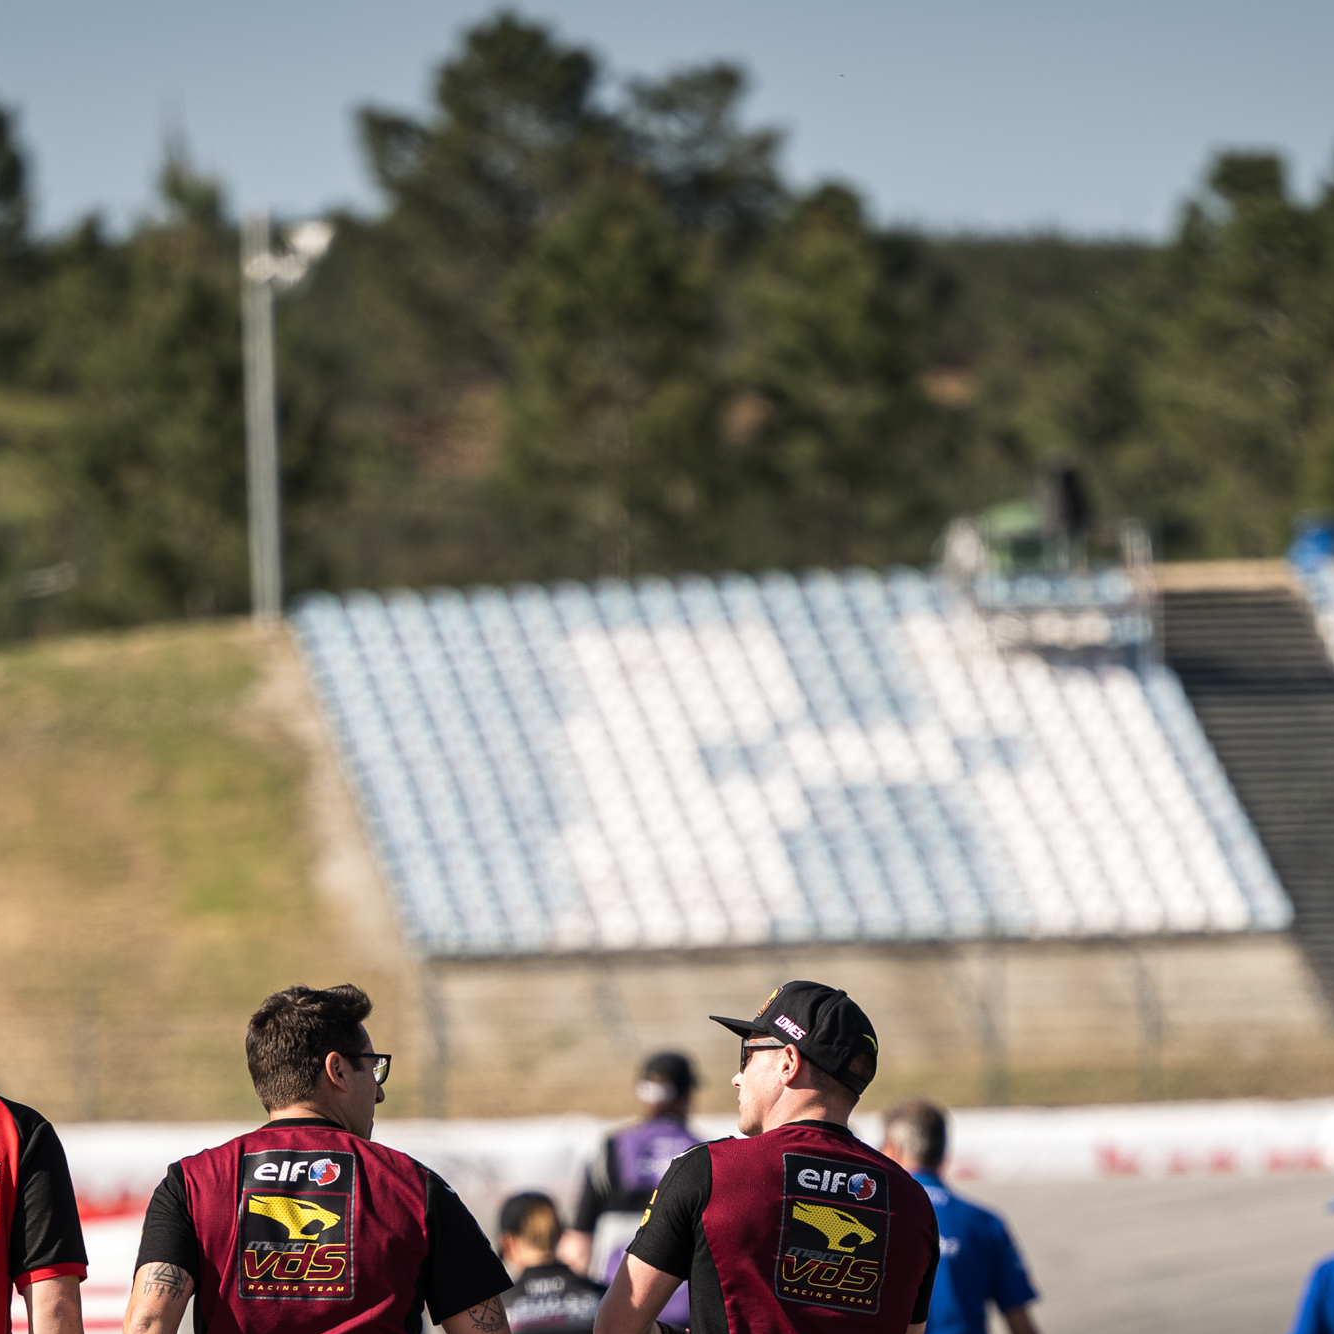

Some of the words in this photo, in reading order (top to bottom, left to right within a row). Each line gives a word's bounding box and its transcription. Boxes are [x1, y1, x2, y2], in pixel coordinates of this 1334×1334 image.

[774, 1014, 807, 1041] LOWES
[253, 1160, 308, 1182] elf
[797, 1168, 847, 1193] elf
[783, 1286, 832, 1299] RACING
[842, 1295, 872, 1305] TEAM
